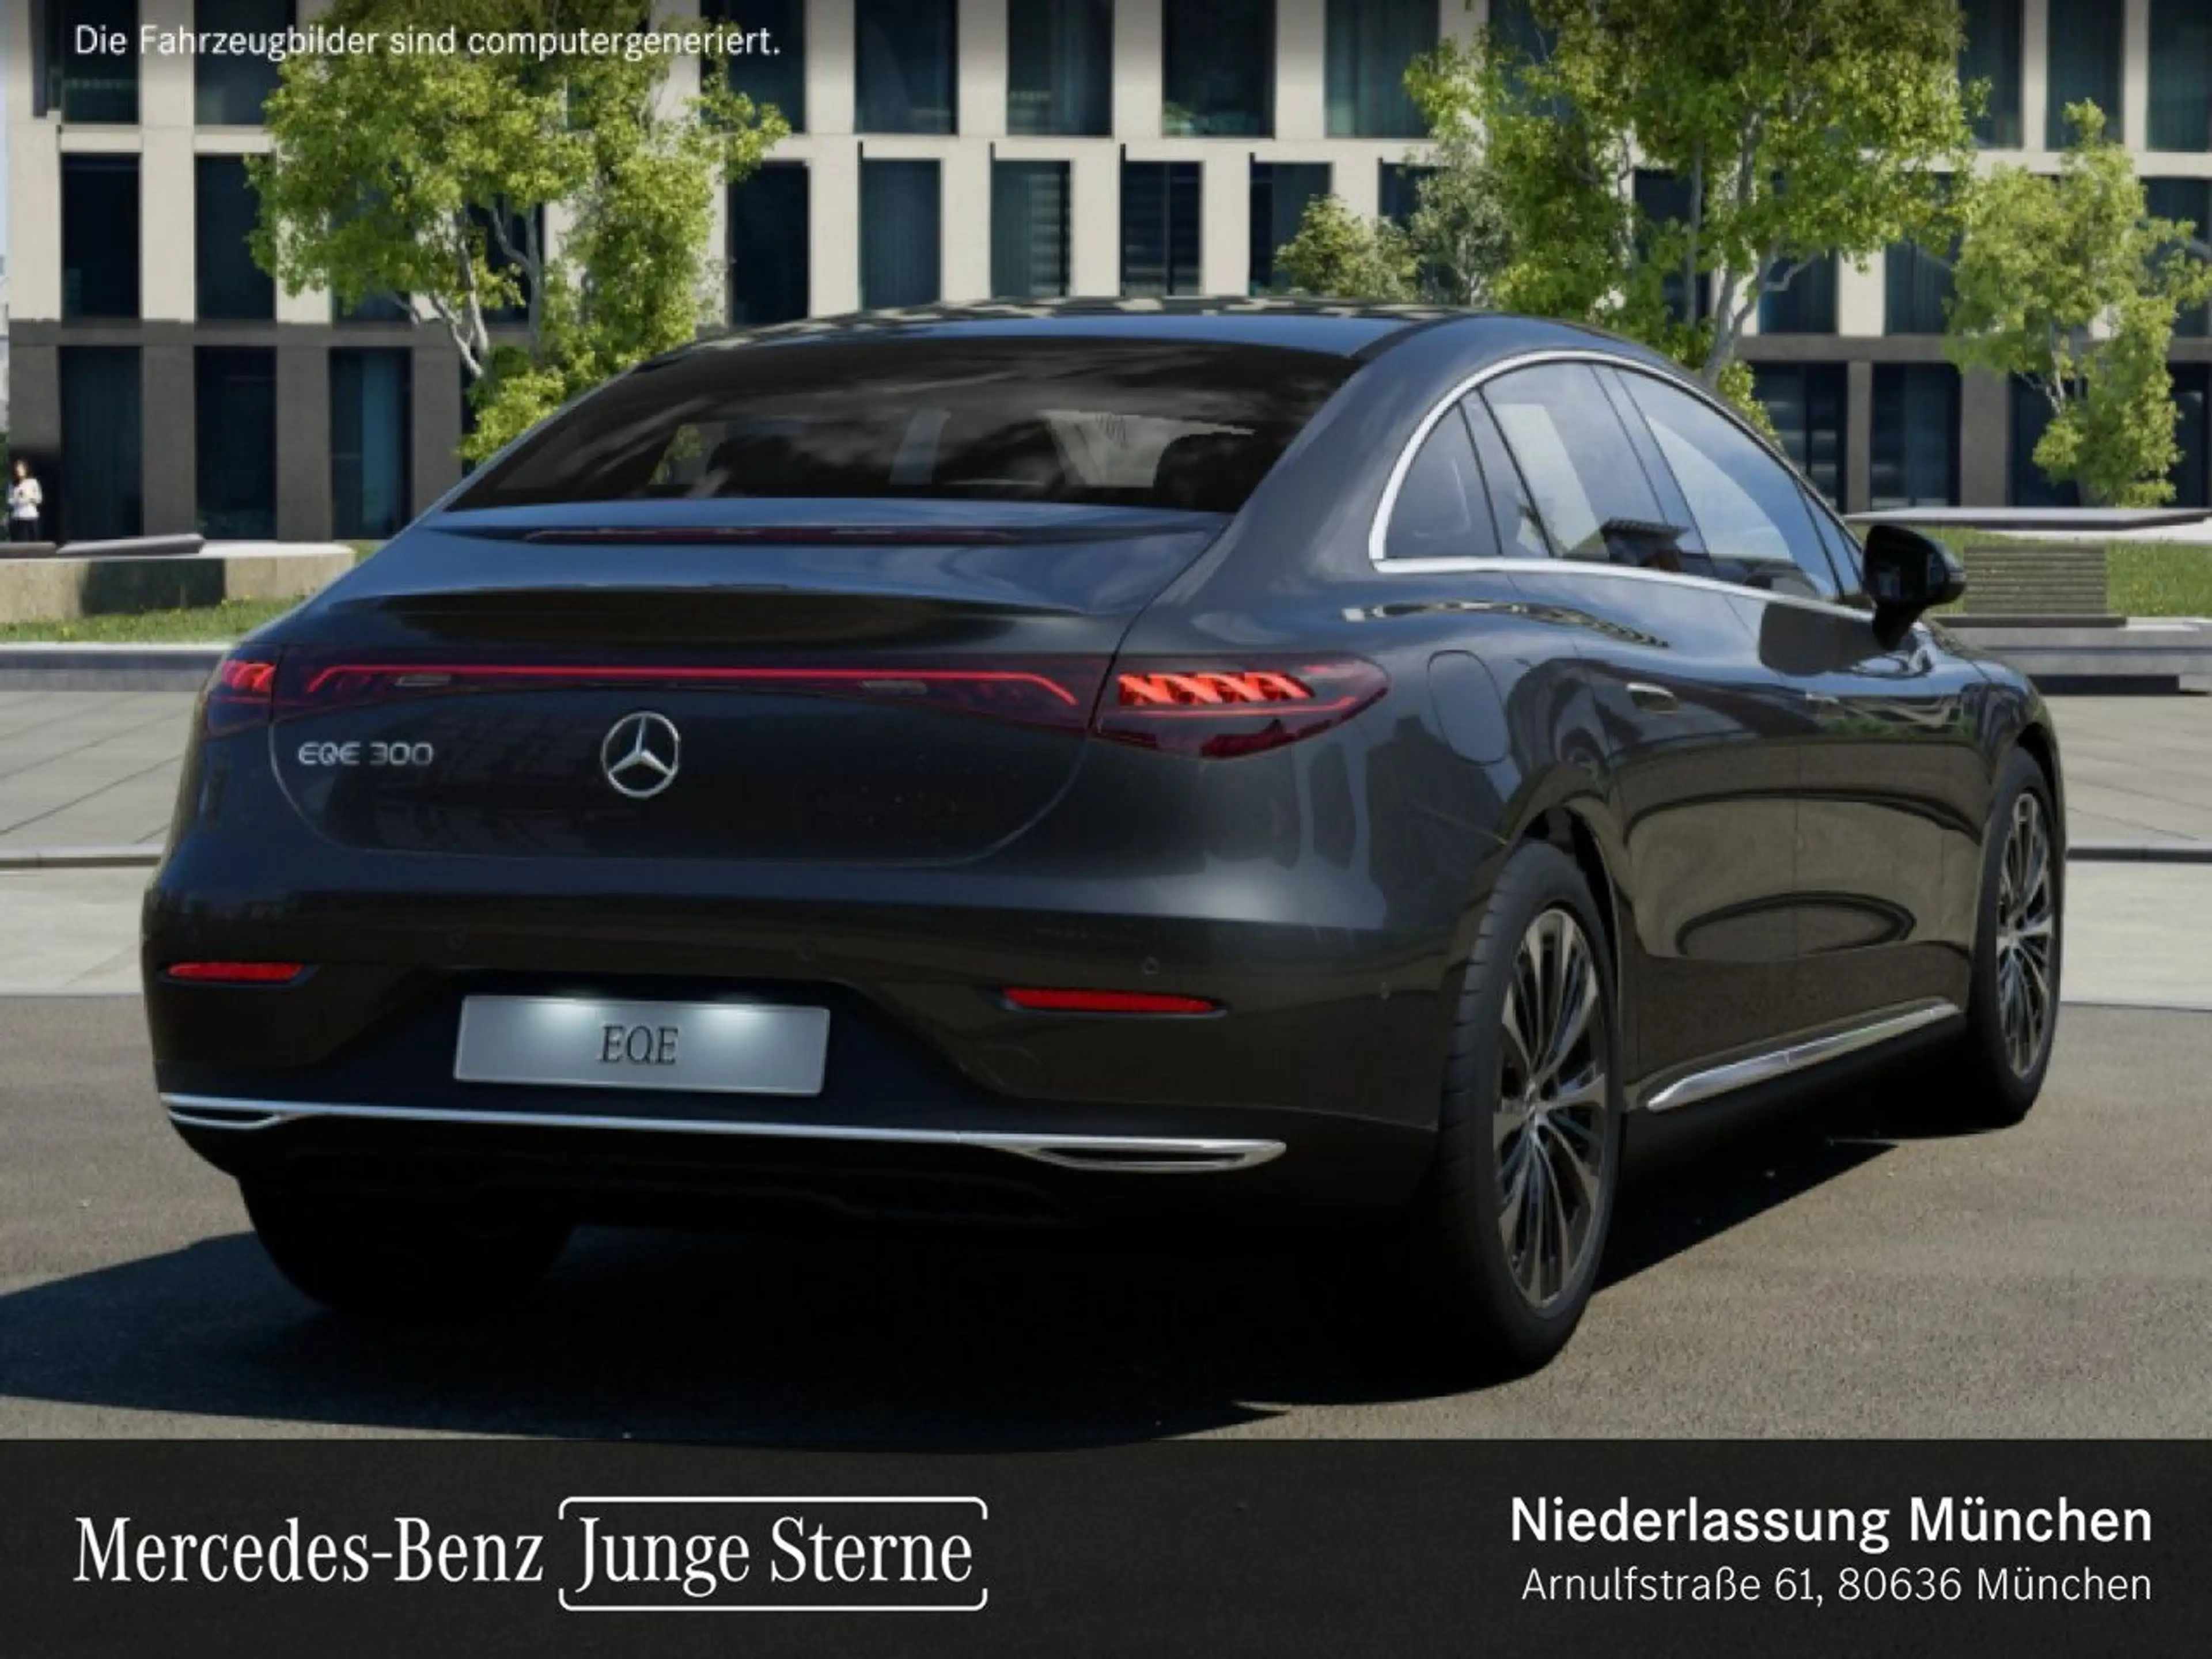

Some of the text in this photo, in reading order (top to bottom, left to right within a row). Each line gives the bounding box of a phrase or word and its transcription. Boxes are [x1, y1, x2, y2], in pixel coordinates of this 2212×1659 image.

[298, 741, 434, 766] EQE 300
[600, 1024, 680, 1066] EQE
